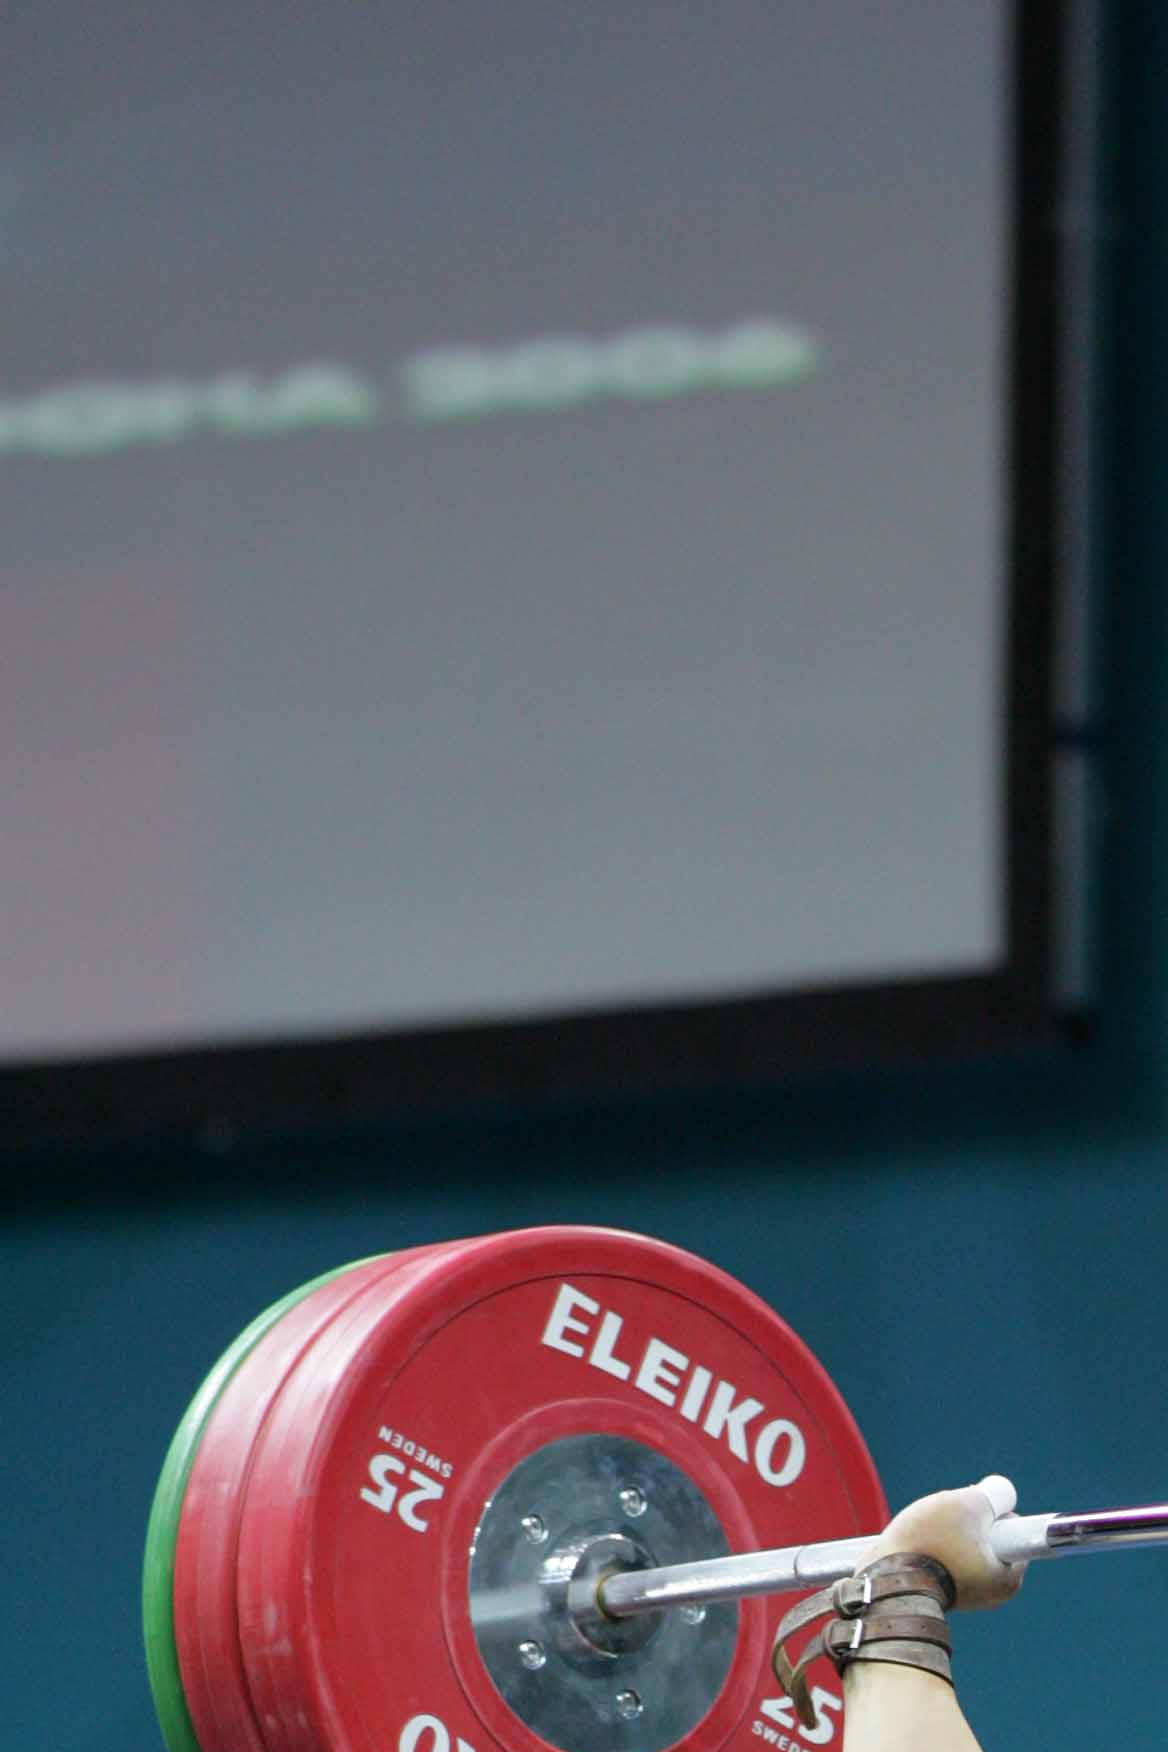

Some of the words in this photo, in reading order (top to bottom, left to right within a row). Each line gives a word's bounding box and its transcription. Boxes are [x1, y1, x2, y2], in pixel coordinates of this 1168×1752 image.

[541, 1283, 806, 1488] ELEIKO
[378, 1424, 453, 1479] SWEDEN
[360, 1452, 444, 1532] 25
[760, 1686, 842, 1745] 25
